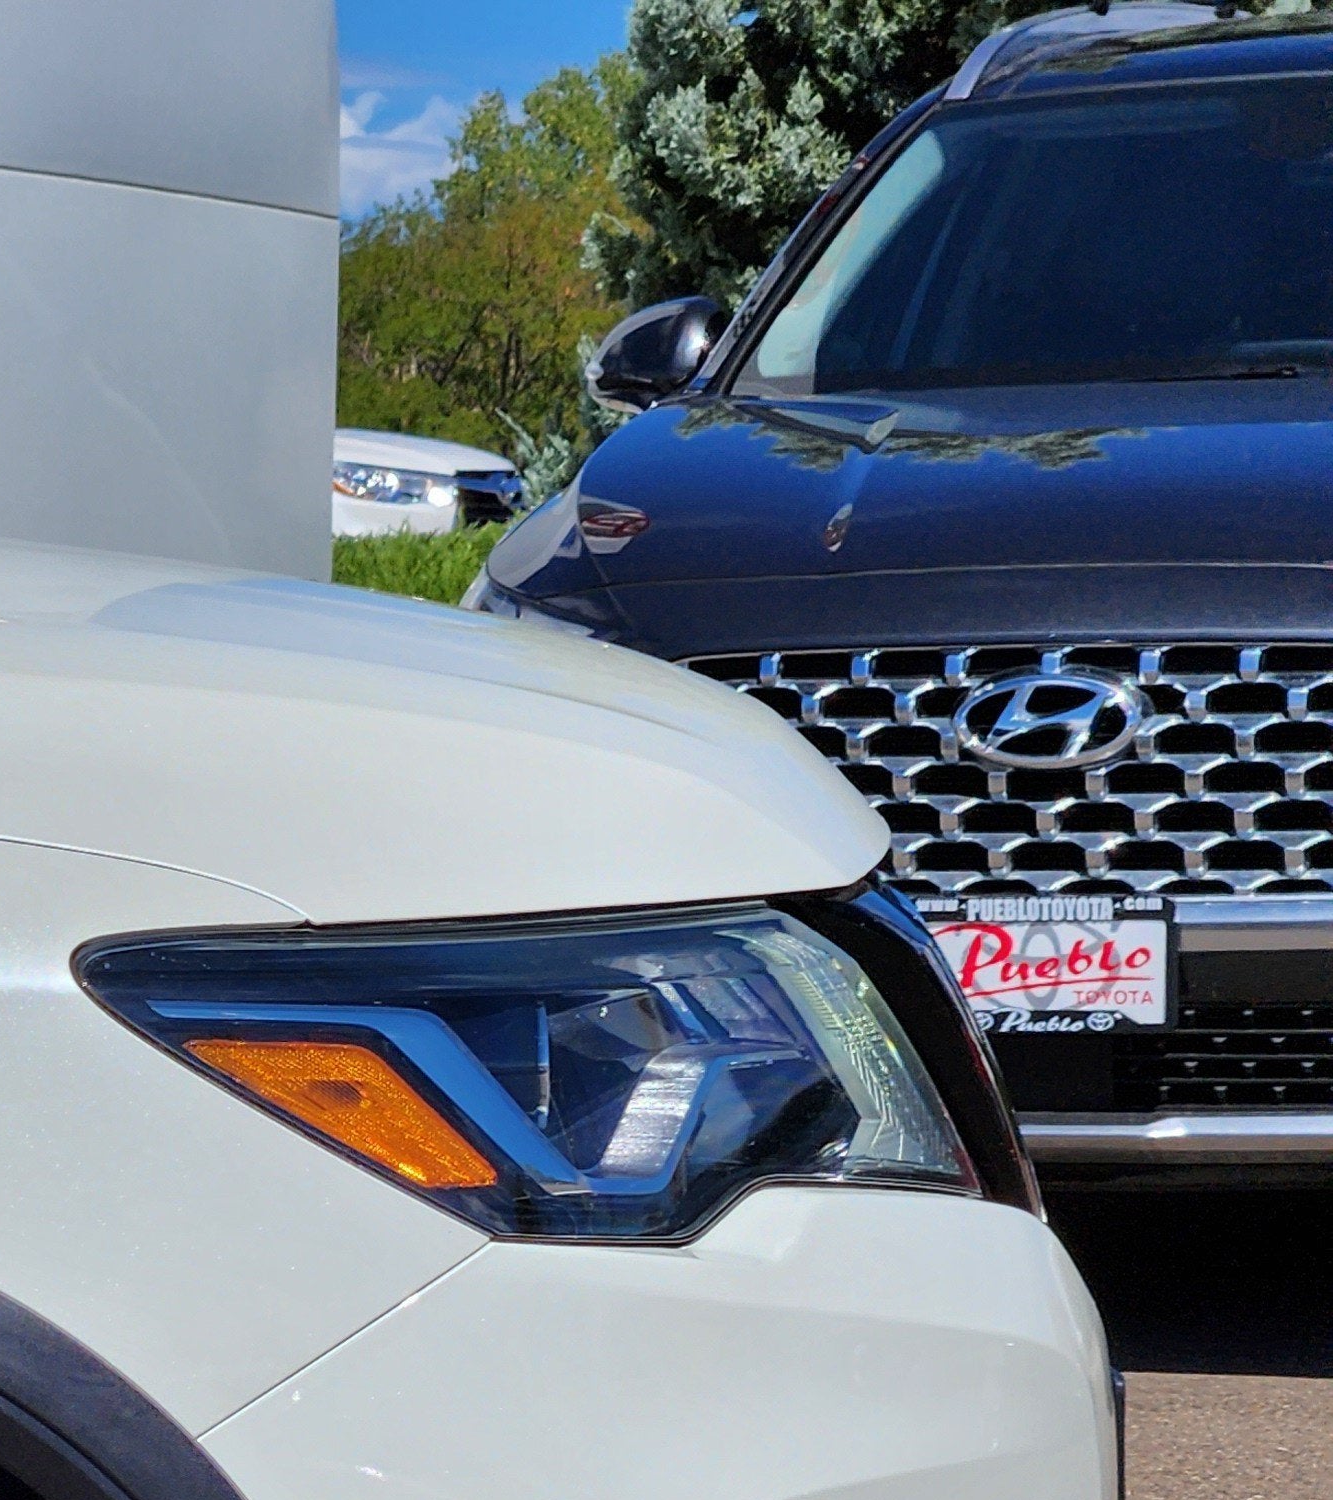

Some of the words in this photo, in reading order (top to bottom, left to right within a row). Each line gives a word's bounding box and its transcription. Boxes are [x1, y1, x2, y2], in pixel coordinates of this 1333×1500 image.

[933, 922, 1152, 989] Pueblo
[1073, 990, 1154, 1006] TOYOTA
[991, 1006, 1086, 1034] Pueblo
